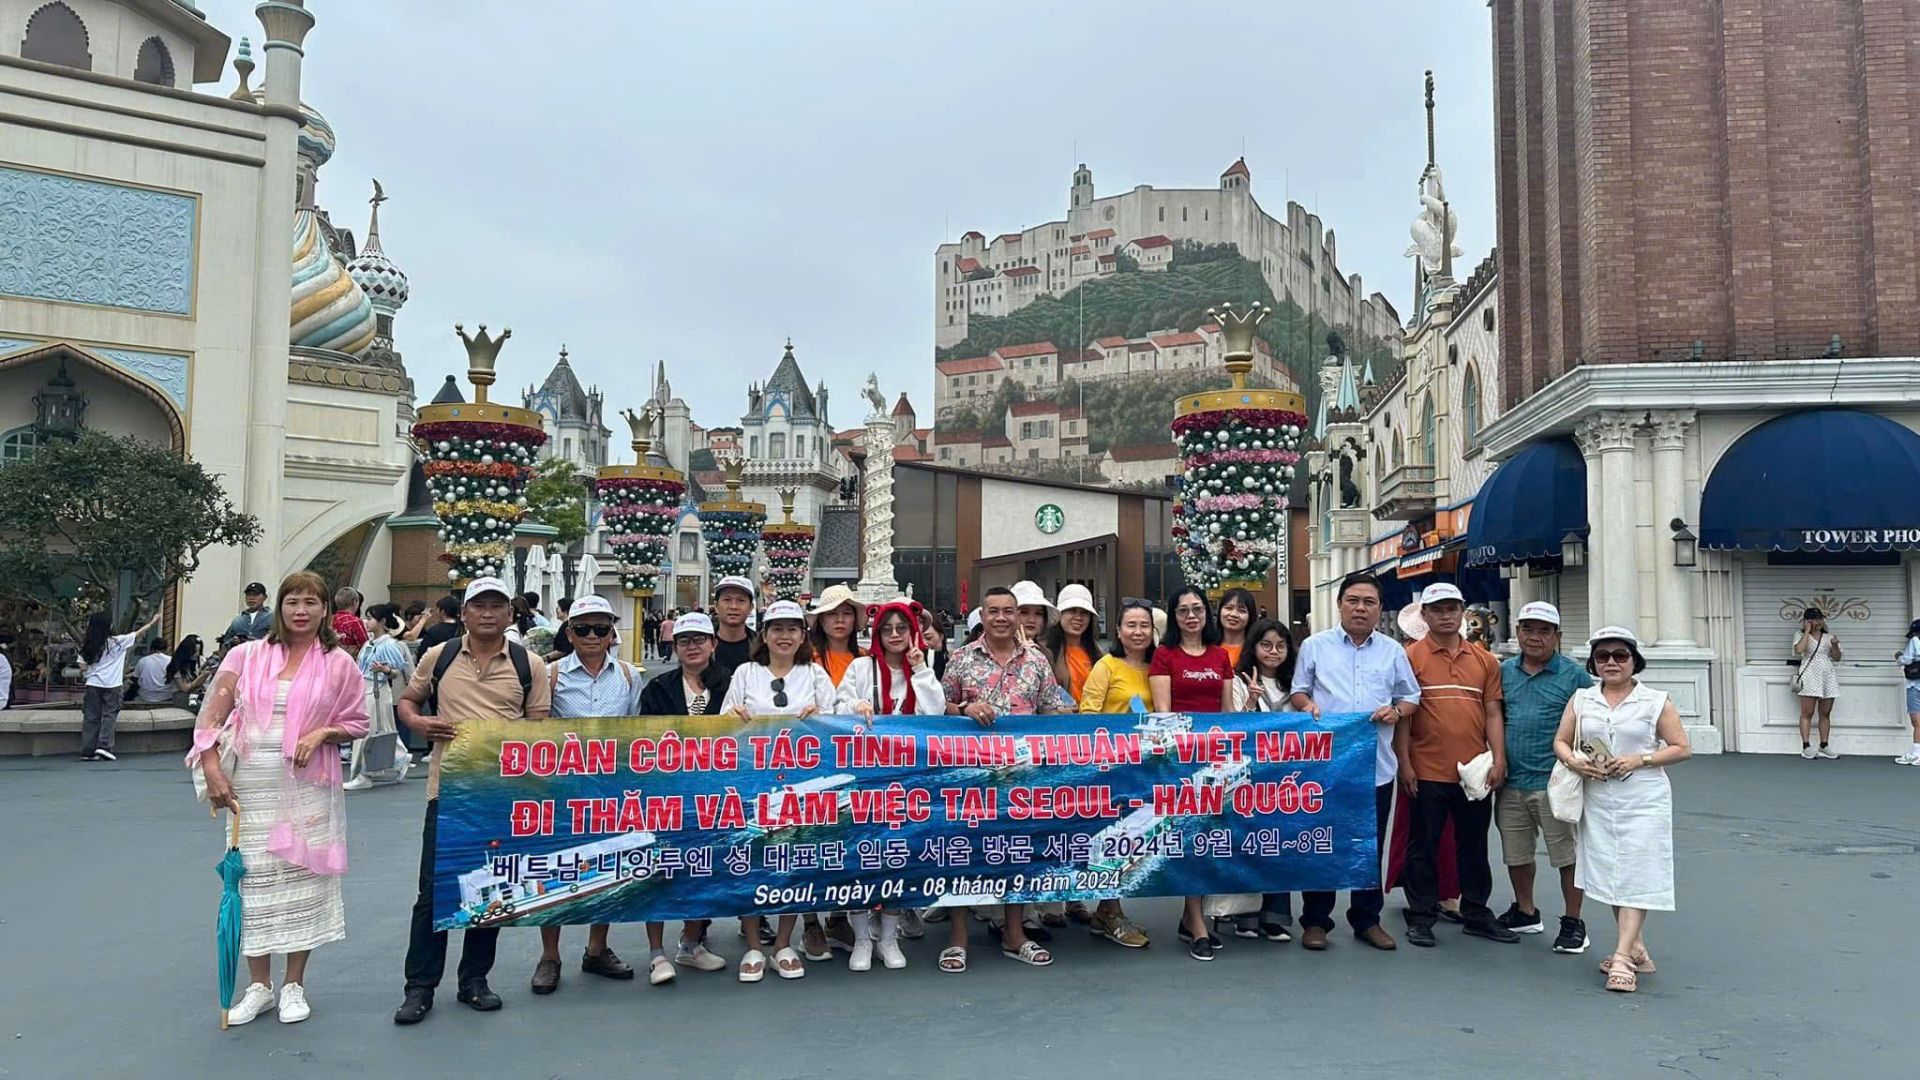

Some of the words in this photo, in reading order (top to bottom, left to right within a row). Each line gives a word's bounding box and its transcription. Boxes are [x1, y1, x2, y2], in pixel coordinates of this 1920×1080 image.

[1277, 519, 1286, 586] TARBUCKS
[1801, 528, 1878, 544] TOWER
[499, 732, 617, 777] ĐOÀN
[629, 730, 738, 774] CÔNG
[749, 728, 821, 769] TÁC
[831, 725, 916, 769] TỈNH
[927, 734, 1015, 767] NINH
[1024, 727, 1142, 771] THUẬN
[1174, 725, 1247, 769] VIỆT
[1255, 731, 1333, 763] NAM
[510, 799, 555, 837] ĐI
[567, 789, 683, 835] THĂM
[694, 786, 746, 829] VÀ
[757, 784, 839, 828] LÀM
[849, 781, 931, 830] VIỆC
[941, 787, 997, 828] TẠI
[1008, 785, 1120, 820] SEOUL
[1152, 777, 1224, 817] HÀN
[1232, 771, 1324, 818] QUỐC
[492, 851, 583, 885] 베트남
[596, 845, 713, 880] 니잉투엔
[723, 844, 751, 876] 성
[763, 839, 847, 873] 대표단
[856, 838, 911, 870] 일동
[918, 836, 973, 867] 서울
[982, 834, 1034, 865] 방문
[1042, 832, 1093, 863] 서울
[1102, 830, 1185, 858] 2024년
[1192, 828, 1233, 858] 9월
[1241, 826, 1333, 857] 4일~8일
[753, 882, 818, 906] Seoul,
[824, 878, 876, 905] ngày
[880, 877, 905, 899] 04
[922, 876, 946, 898] 08
[951, 873, 1007, 898] tháng
[1012, 873, 1025, 892] 9
[1029, 872, 1070, 892] năm
[1075, 870, 1121, 890] 2024
